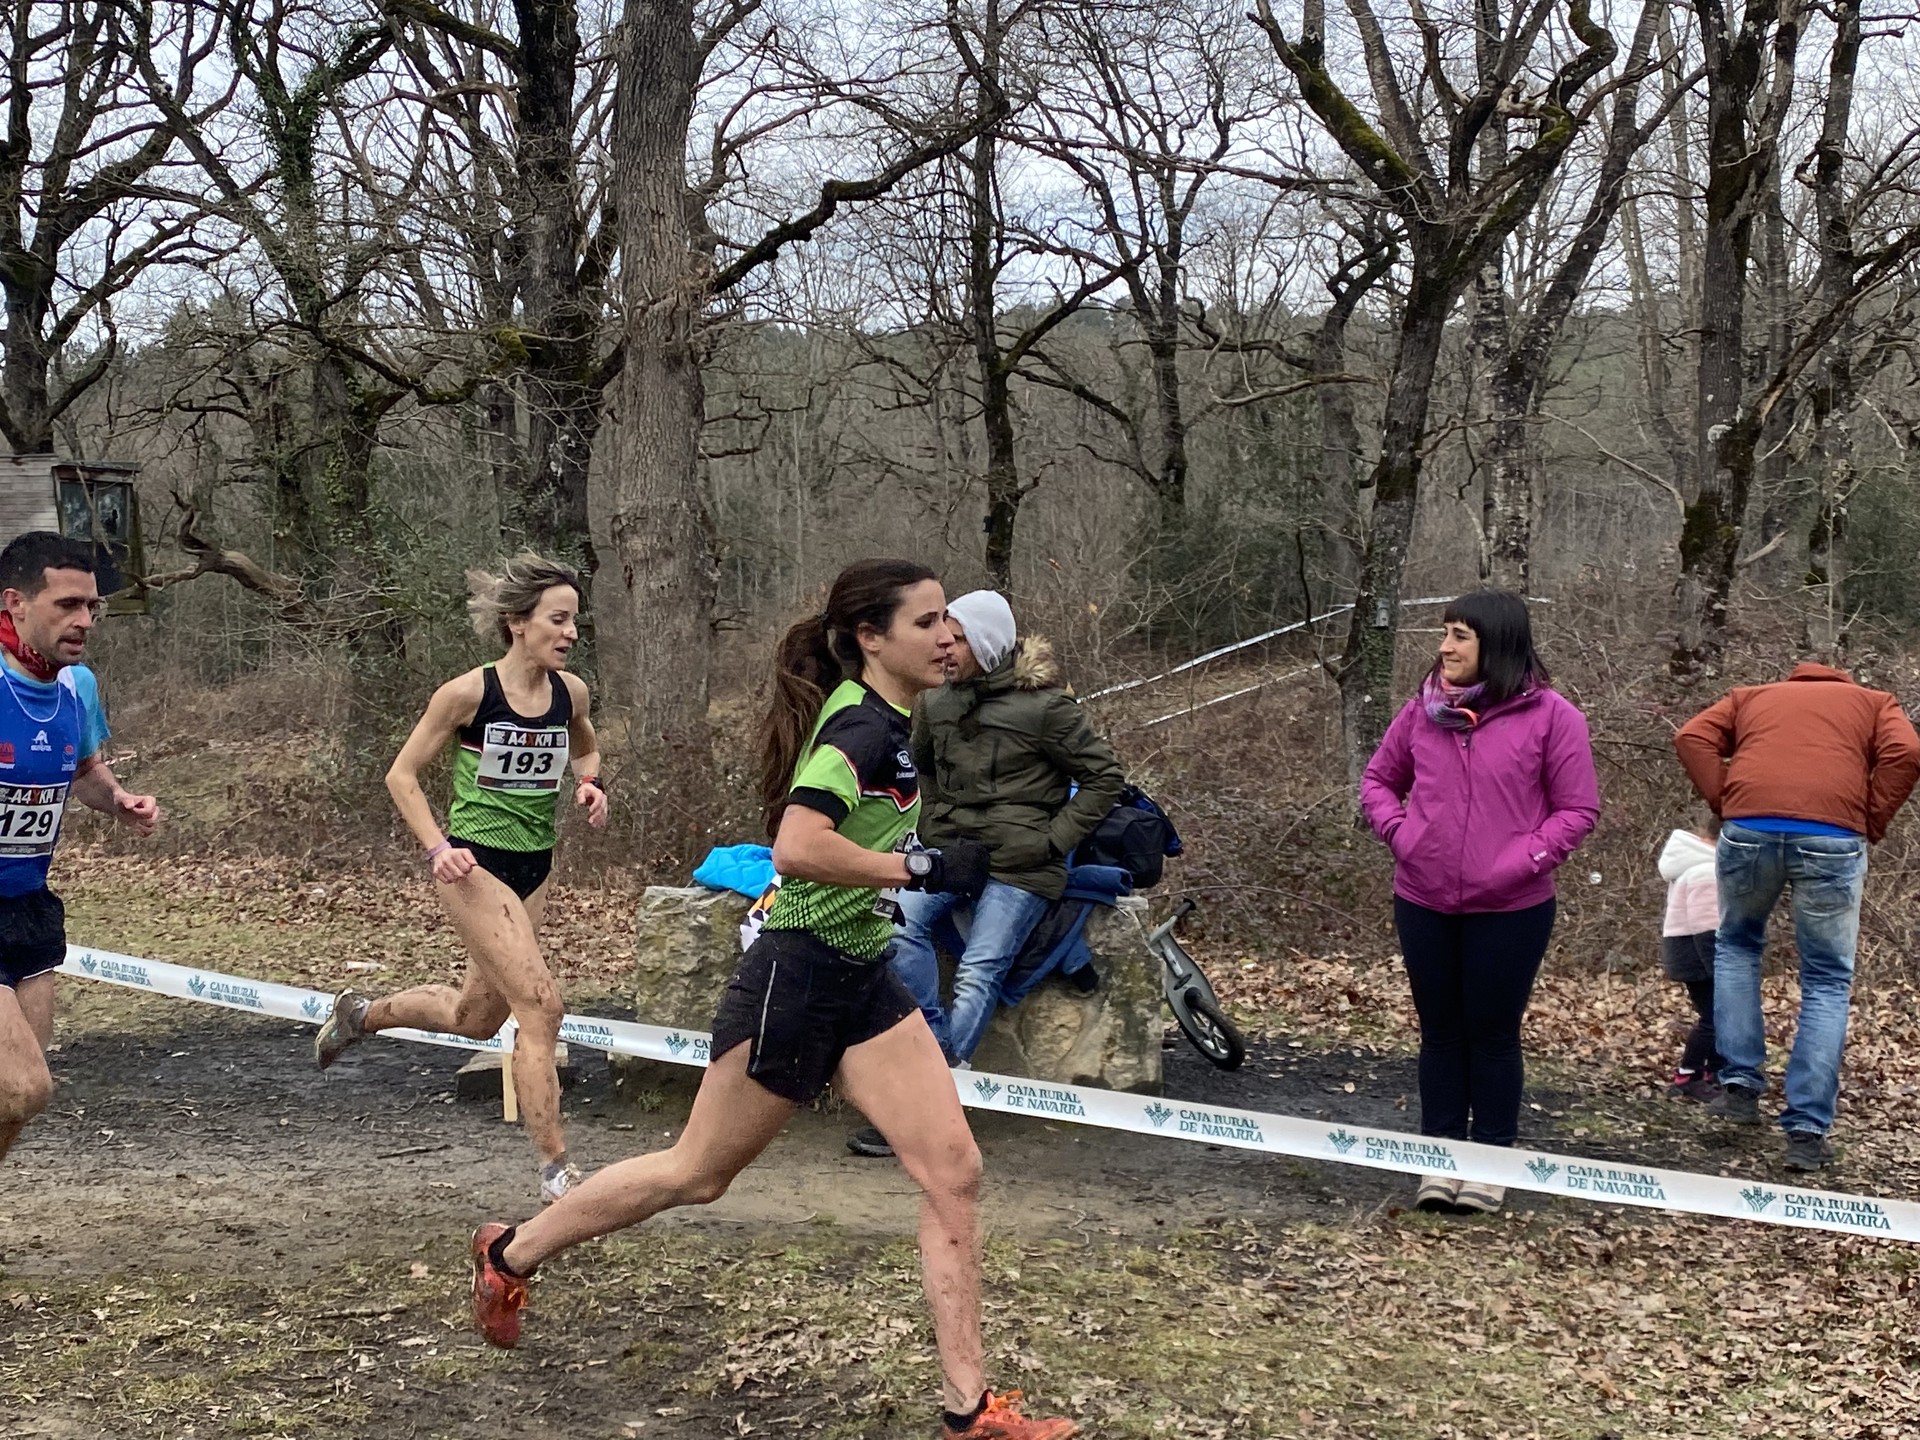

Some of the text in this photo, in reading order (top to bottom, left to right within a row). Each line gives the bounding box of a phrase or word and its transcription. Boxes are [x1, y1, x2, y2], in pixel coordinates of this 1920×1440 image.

[497, 751, 554, 774] 193
[0, 810, 53, 837] 129
[210, 982, 260, 1000] CAJA RURAL
[578, 1024, 613, 1036] RURAL
[692, 1050, 709, 1060] DE
[1007, 1084, 1081, 1104] CAJA RURAL
[1007, 1095, 1086, 1117] DE NAVARRA
[1180, 1109, 1259, 1130] CAJA RURAL
[1179, 1120, 1264, 1143] DE NAVARRA
[1366, 1137, 1452, 1158] CAJA RURAL
[1365, 1147, 1457, 1171] DE NAVARRA
[1567, 1165, 1660, 1186] CAJA RURAL
[1567, 1176, 1666, 1200] DE NAVARRA
[1785, 1193, 1885, 1215] CAJA RURAL
[1784, 1204, 1891, 1230] DE NAVARRA
